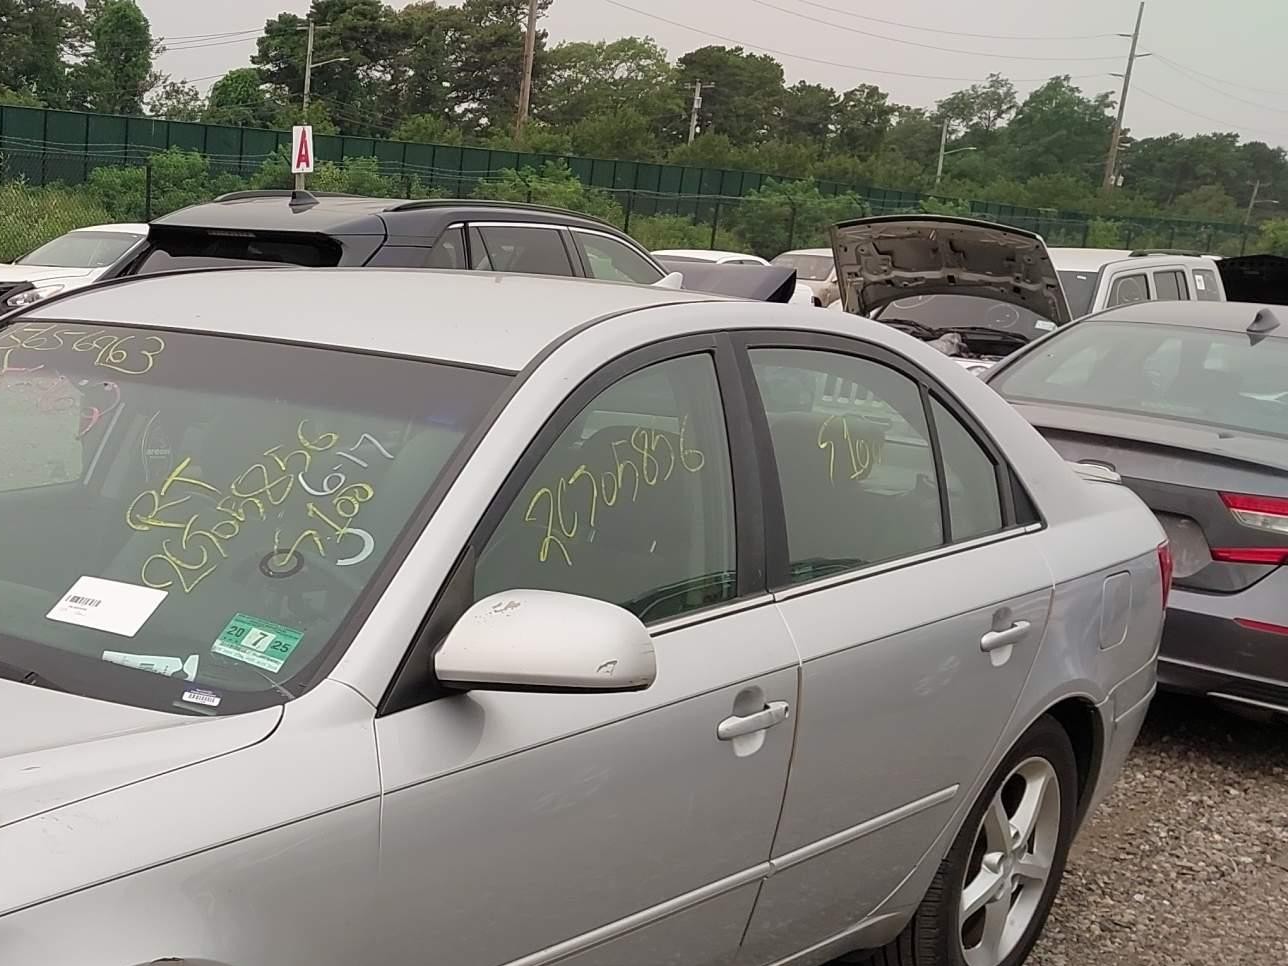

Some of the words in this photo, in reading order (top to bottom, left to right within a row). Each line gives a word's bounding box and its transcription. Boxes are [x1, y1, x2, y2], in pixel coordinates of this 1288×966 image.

[295, 126, 310, 169] A
[126, 457, 222, 531] RT
[226, 625, 246, 639] 20
[253, 631, 268, 647] 7
[272, 640, 290, 653] 25
